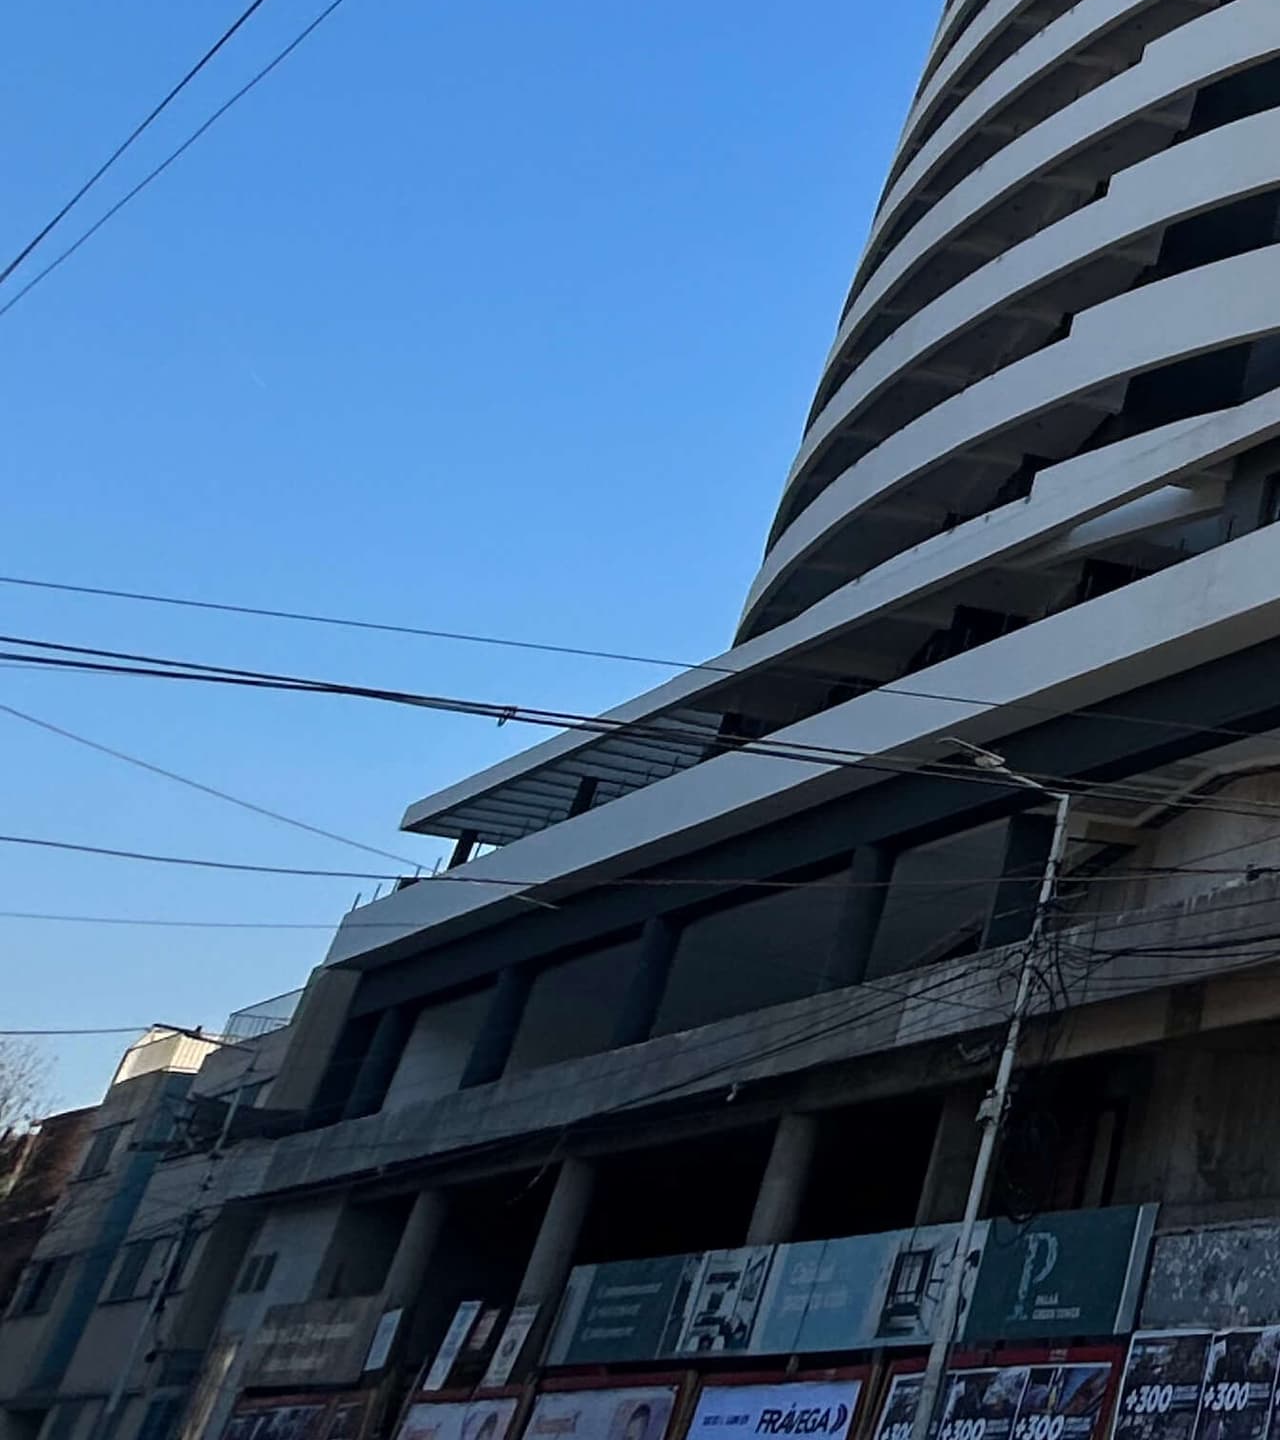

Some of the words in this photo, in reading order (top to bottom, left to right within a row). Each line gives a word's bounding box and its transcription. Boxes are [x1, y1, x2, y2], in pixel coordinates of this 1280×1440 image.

[1125, 1384, 1173, 1413] +300
[1204, 1381, 1250, 1411] +300
[755, 1403, 830, 1434] FRÁVEGA
[1015, 1414, 1064, 1440] +300
